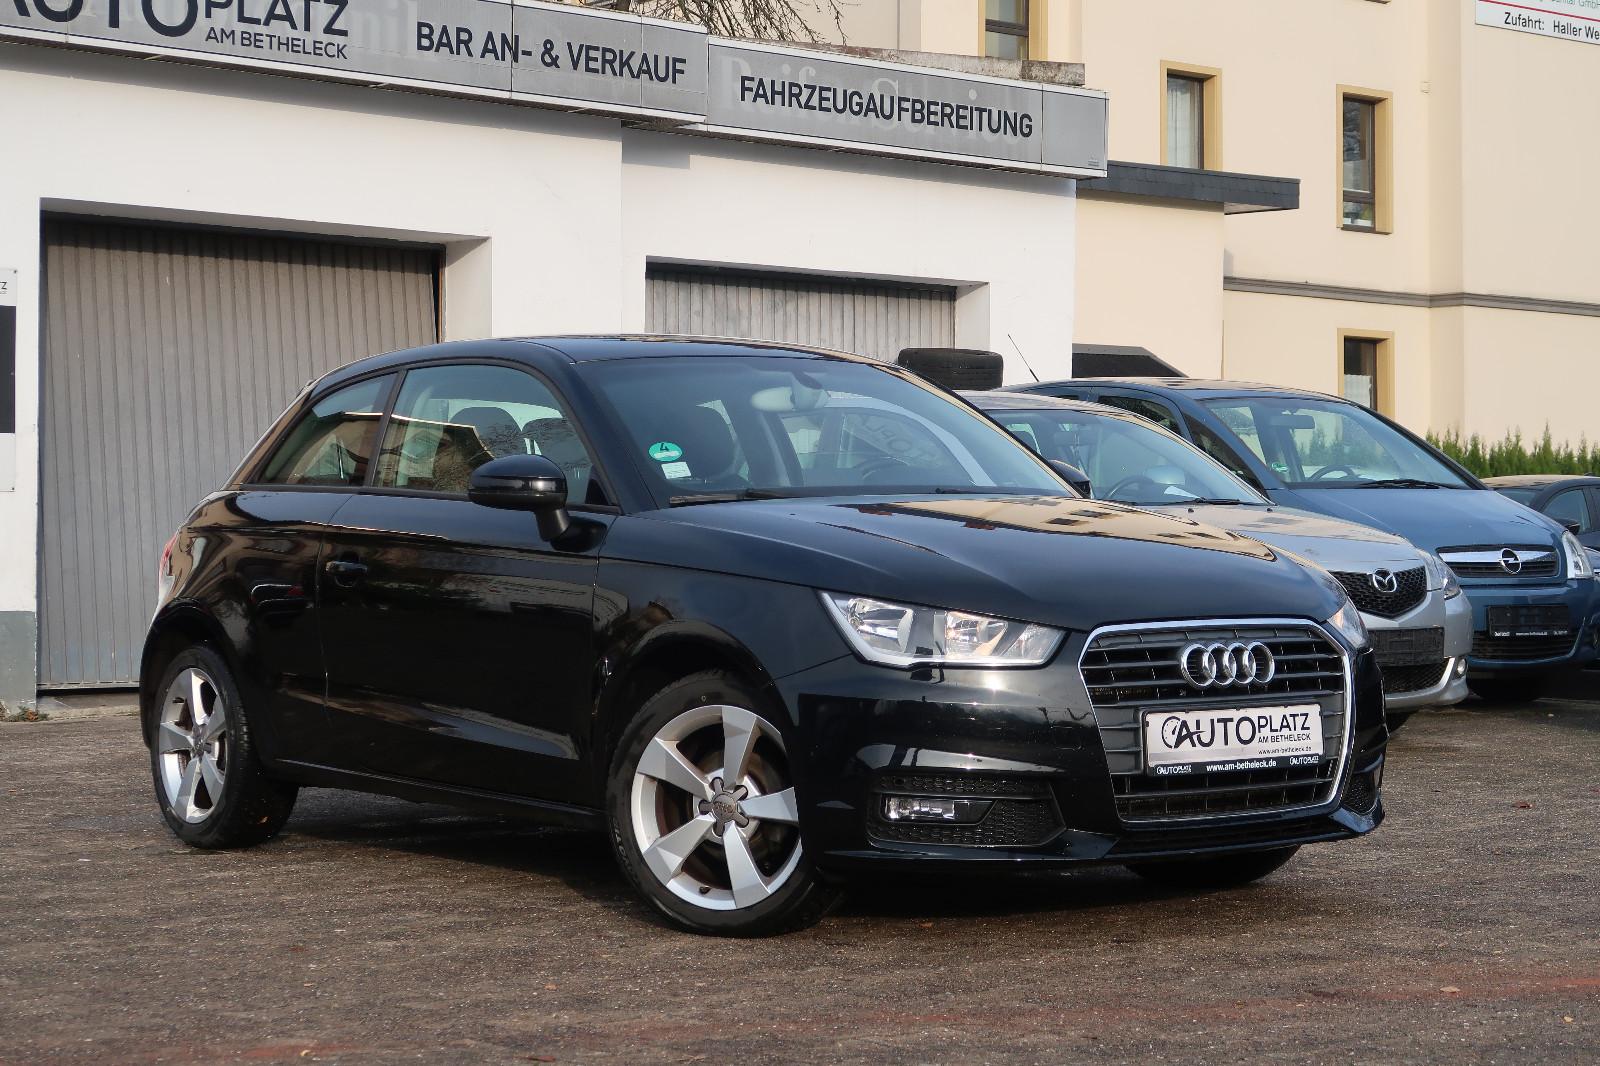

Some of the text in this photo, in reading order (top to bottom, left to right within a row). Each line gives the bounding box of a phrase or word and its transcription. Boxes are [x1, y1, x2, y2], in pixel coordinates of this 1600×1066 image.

[1504, 11, 1545, 31] Zufahrt:
[1553, 20, 1582, 37] Haller
[205, 27, 348, 59] AM BETHELECK
[416, 21, 473, 57] BAR
[480, 30, 532, 63] AN-
[540, 38, 560, 68] &
[567, 41, 687, 84] VERKAUF
[740, 75, 1033, 138] FAHRZEUGAUFBEREITUNG
[1258, 733, 1311, 744] AM BETHELECK
[1206, 759, 1277, 771] www.am-betheleck.de
